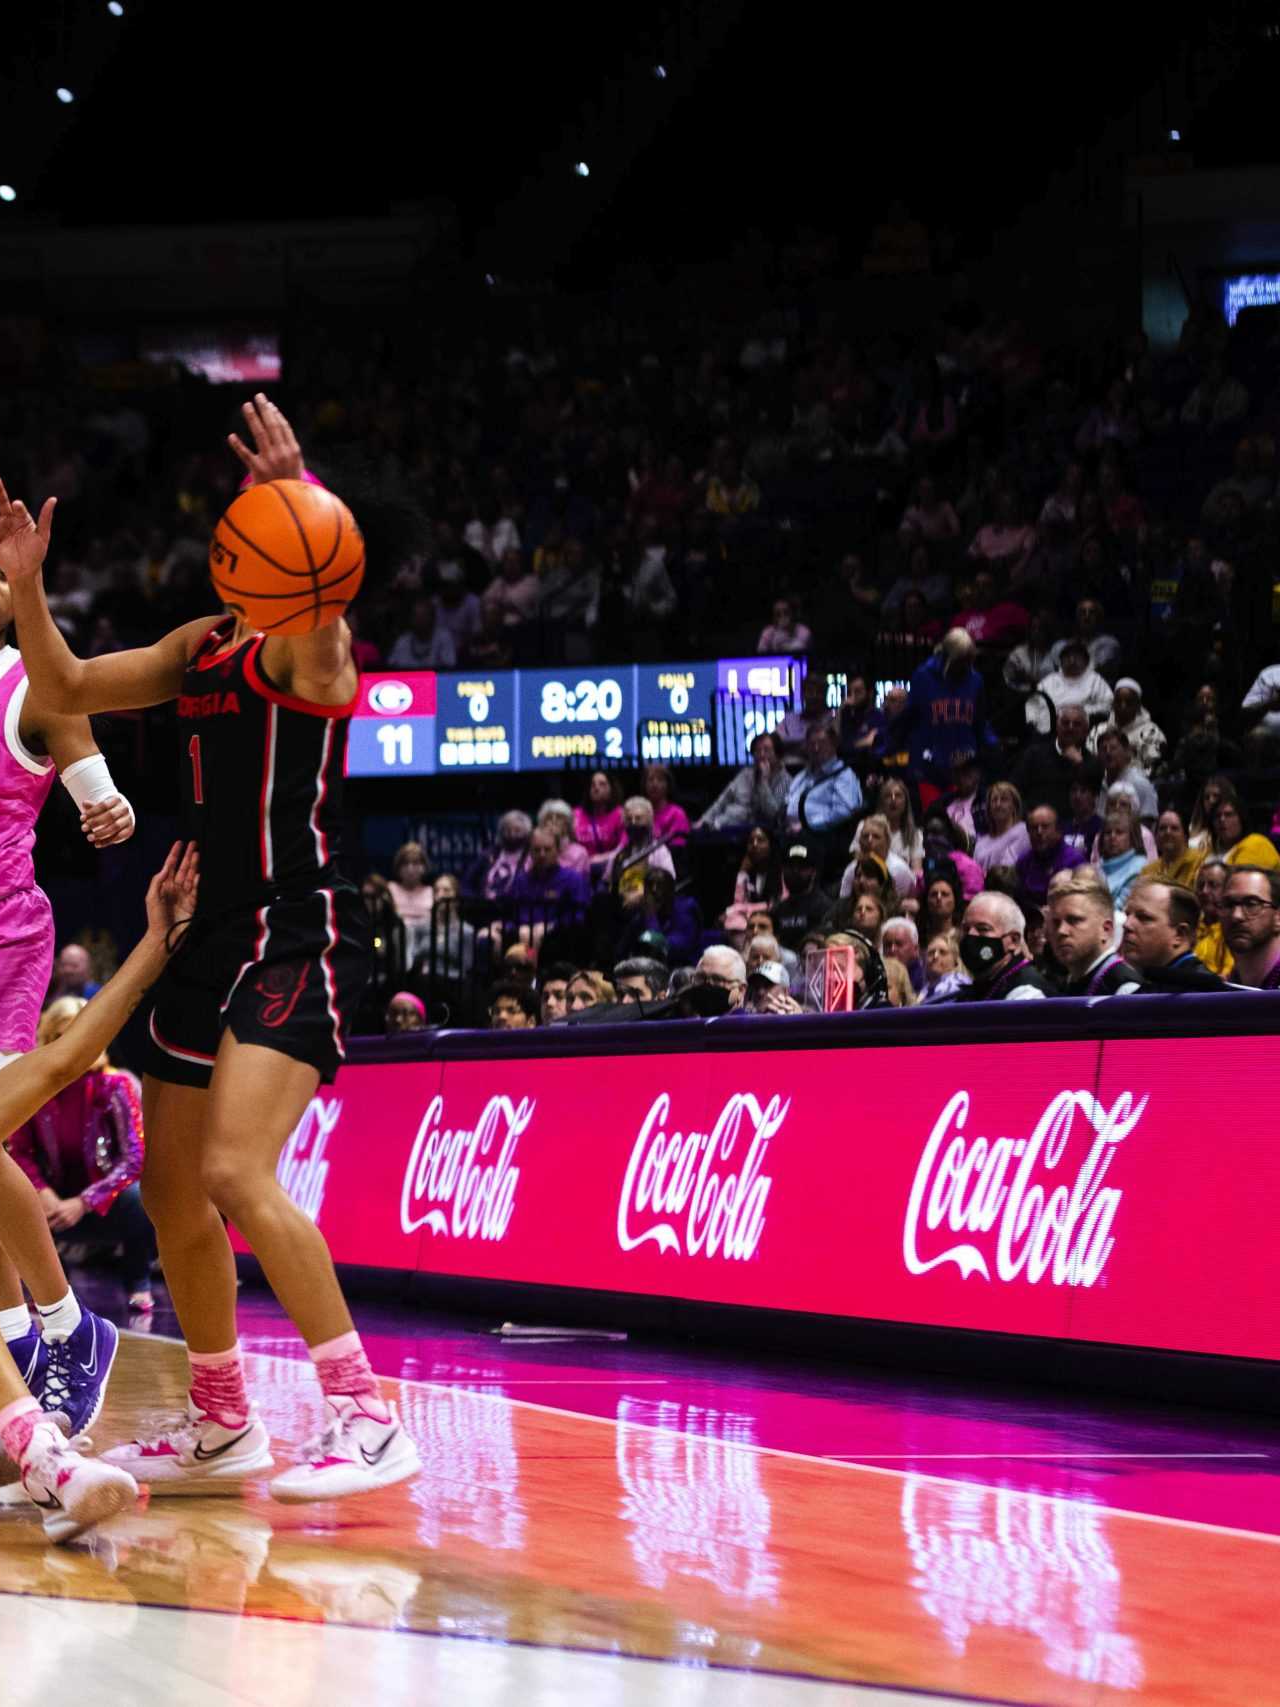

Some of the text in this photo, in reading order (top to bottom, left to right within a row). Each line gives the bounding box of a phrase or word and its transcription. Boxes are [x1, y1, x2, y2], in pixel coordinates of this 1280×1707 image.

[468, 693, 490, 723] 0
[540, 679, 623, 723] 8:20
[670, 687, 689, 715] 0
[376, 723, 413, 765] 11
[531, 734, 597, 758] PERIOD
[604, 726, 623, 758] 2
[188, 734, 204, 804] 1
[400, 1094, 536, 1242] Coca-Cola
[616, 1091, 791, 1262] Coca-Cola
[902, 1089, 1151, 1288] Coca-Cola
